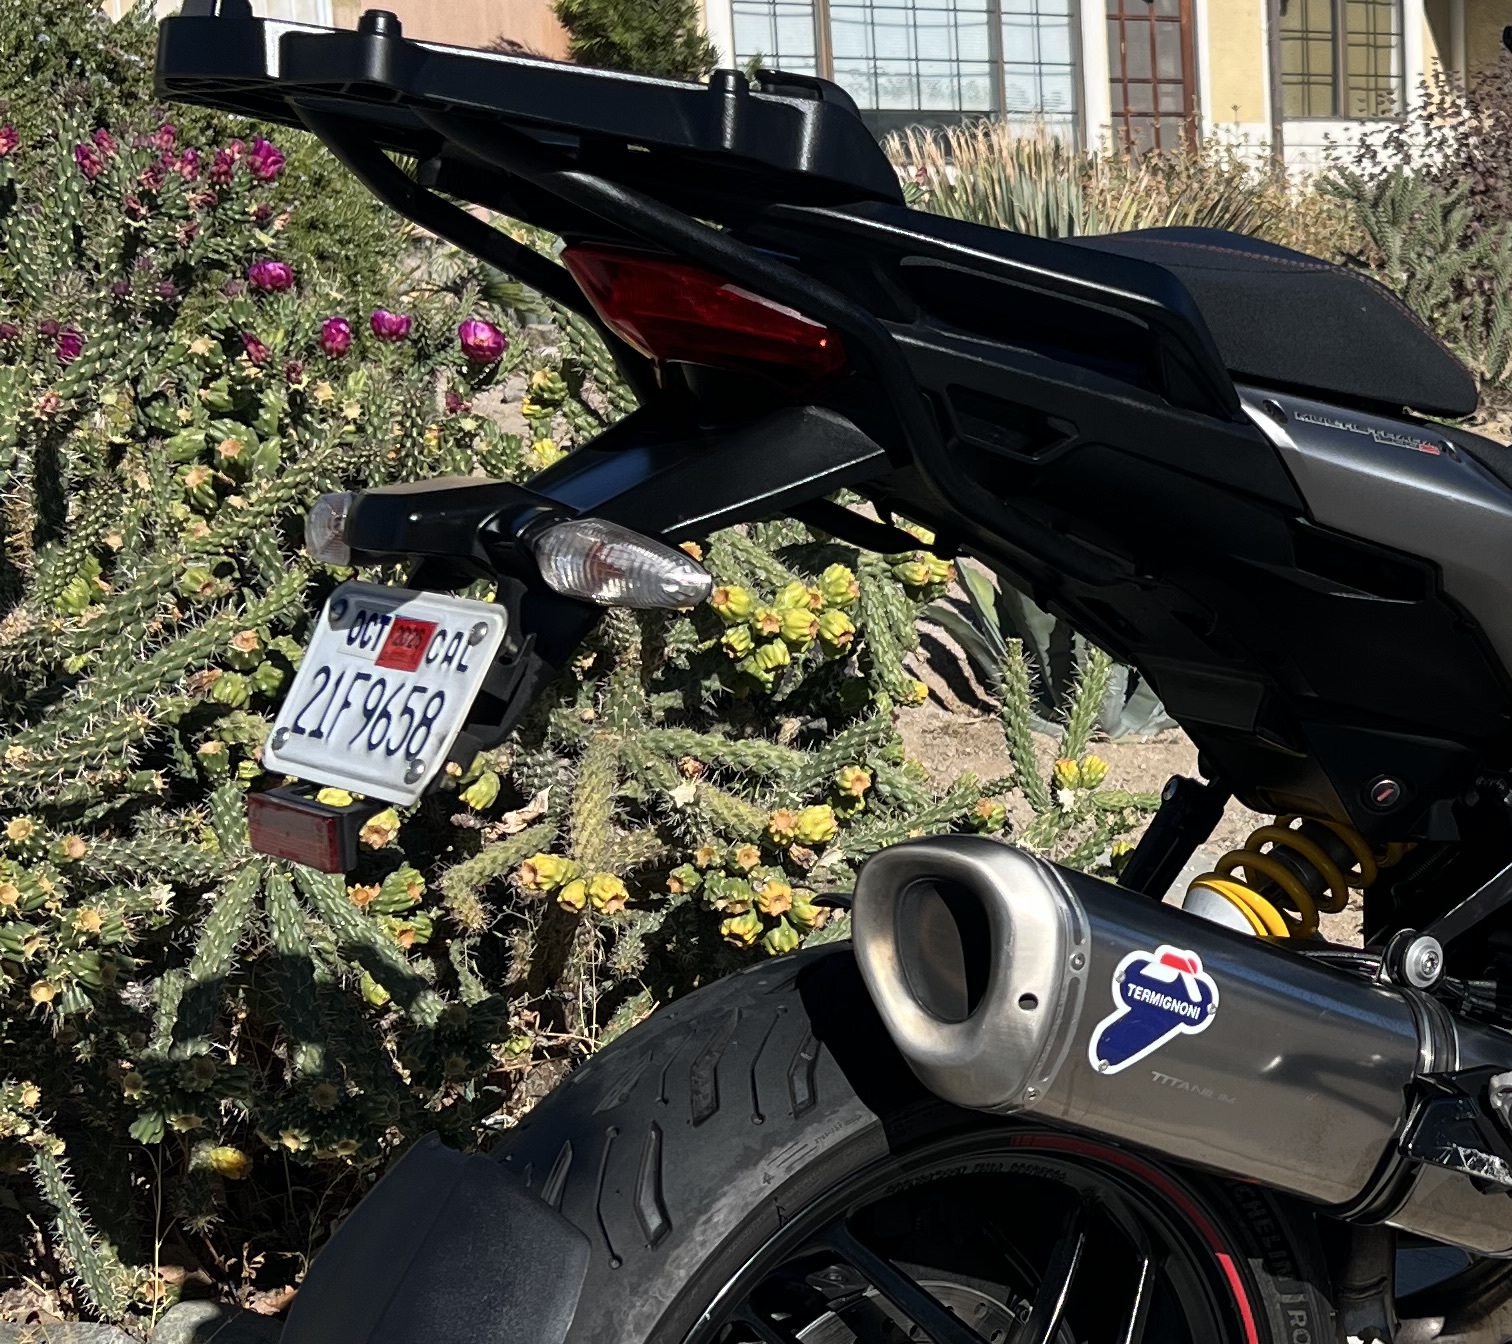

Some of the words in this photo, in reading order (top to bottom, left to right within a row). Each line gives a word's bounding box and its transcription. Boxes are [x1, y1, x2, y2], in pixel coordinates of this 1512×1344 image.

[346, 609, 393, 652] OCT
[426, 629, 472, 672] CAL
[291, 665, 446, 761] 21F9658
[1127, 982, 1201, 1020] TERMIGNONI
